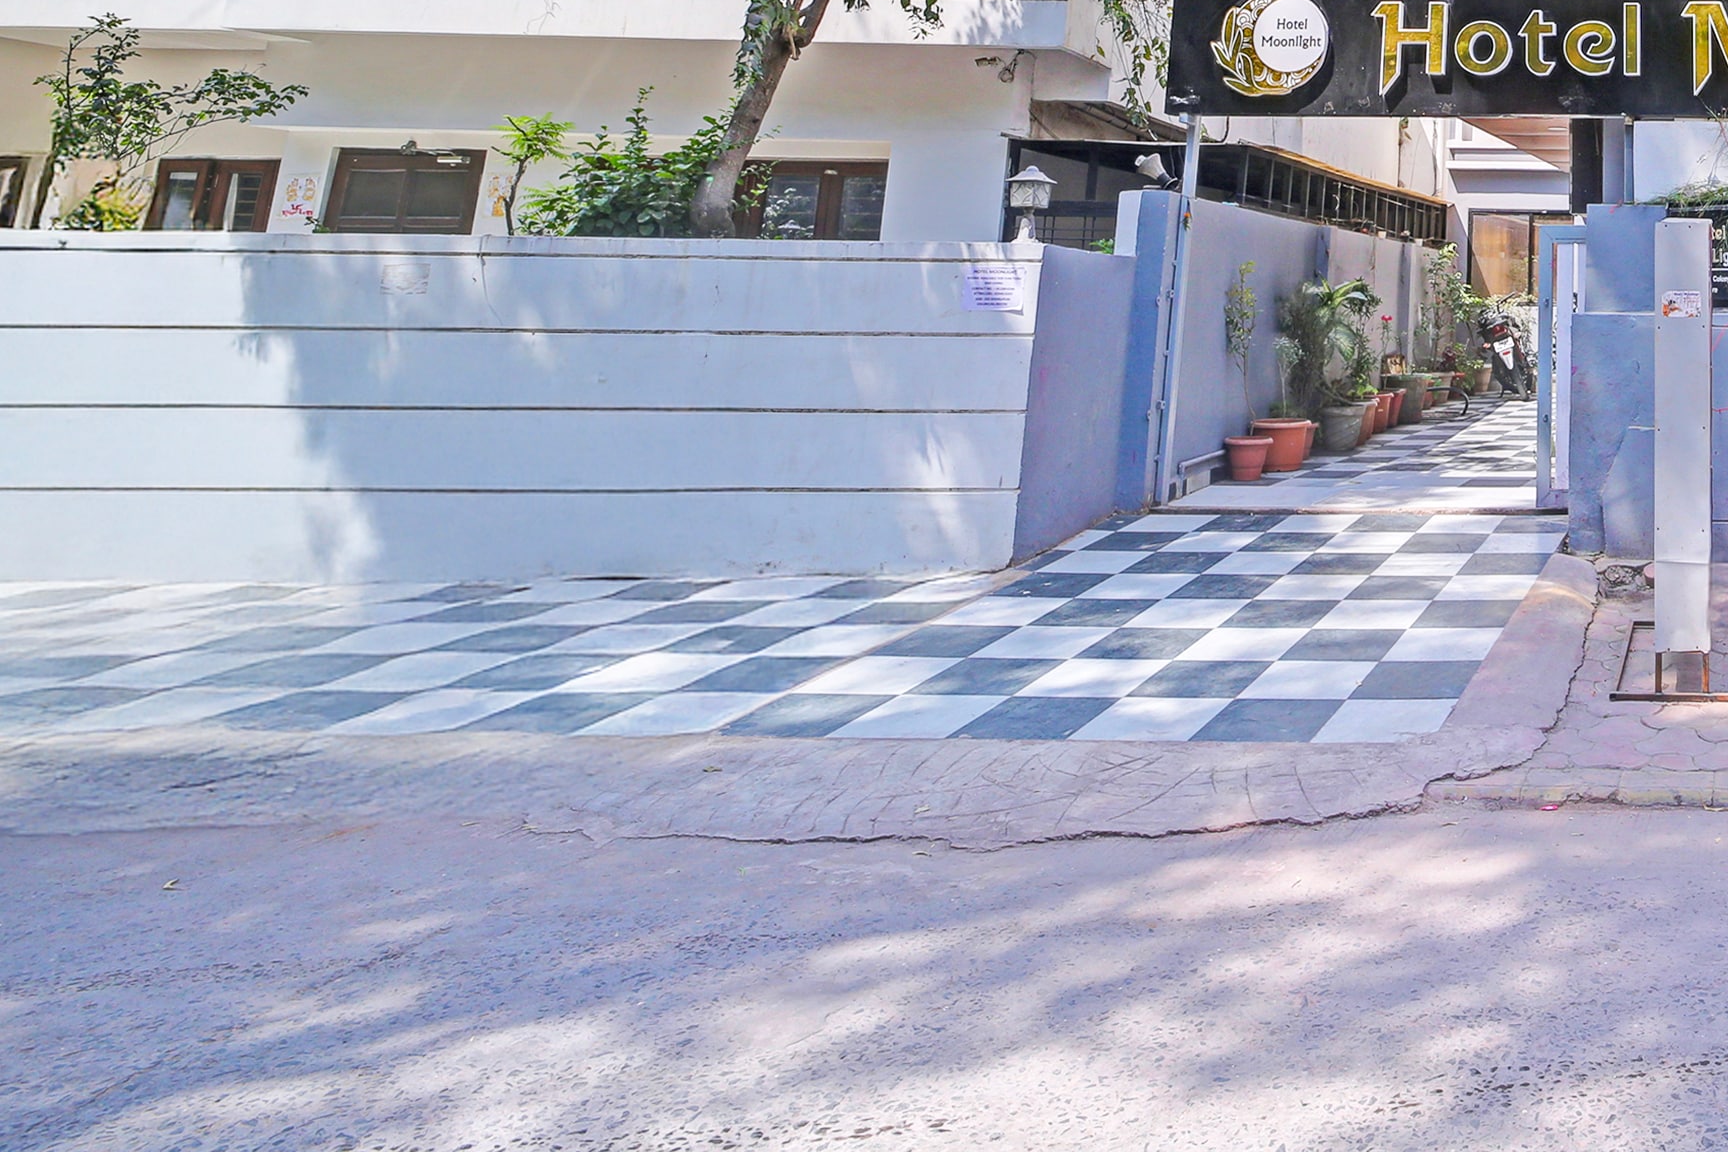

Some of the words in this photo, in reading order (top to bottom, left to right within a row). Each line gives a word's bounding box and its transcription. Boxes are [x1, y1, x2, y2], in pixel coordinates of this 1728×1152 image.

[1276, 18, 1308, 30] Hotel
[1261, 35, 1322, 50] Moonlight
[1370, 0, 1641, 98] Hotel
